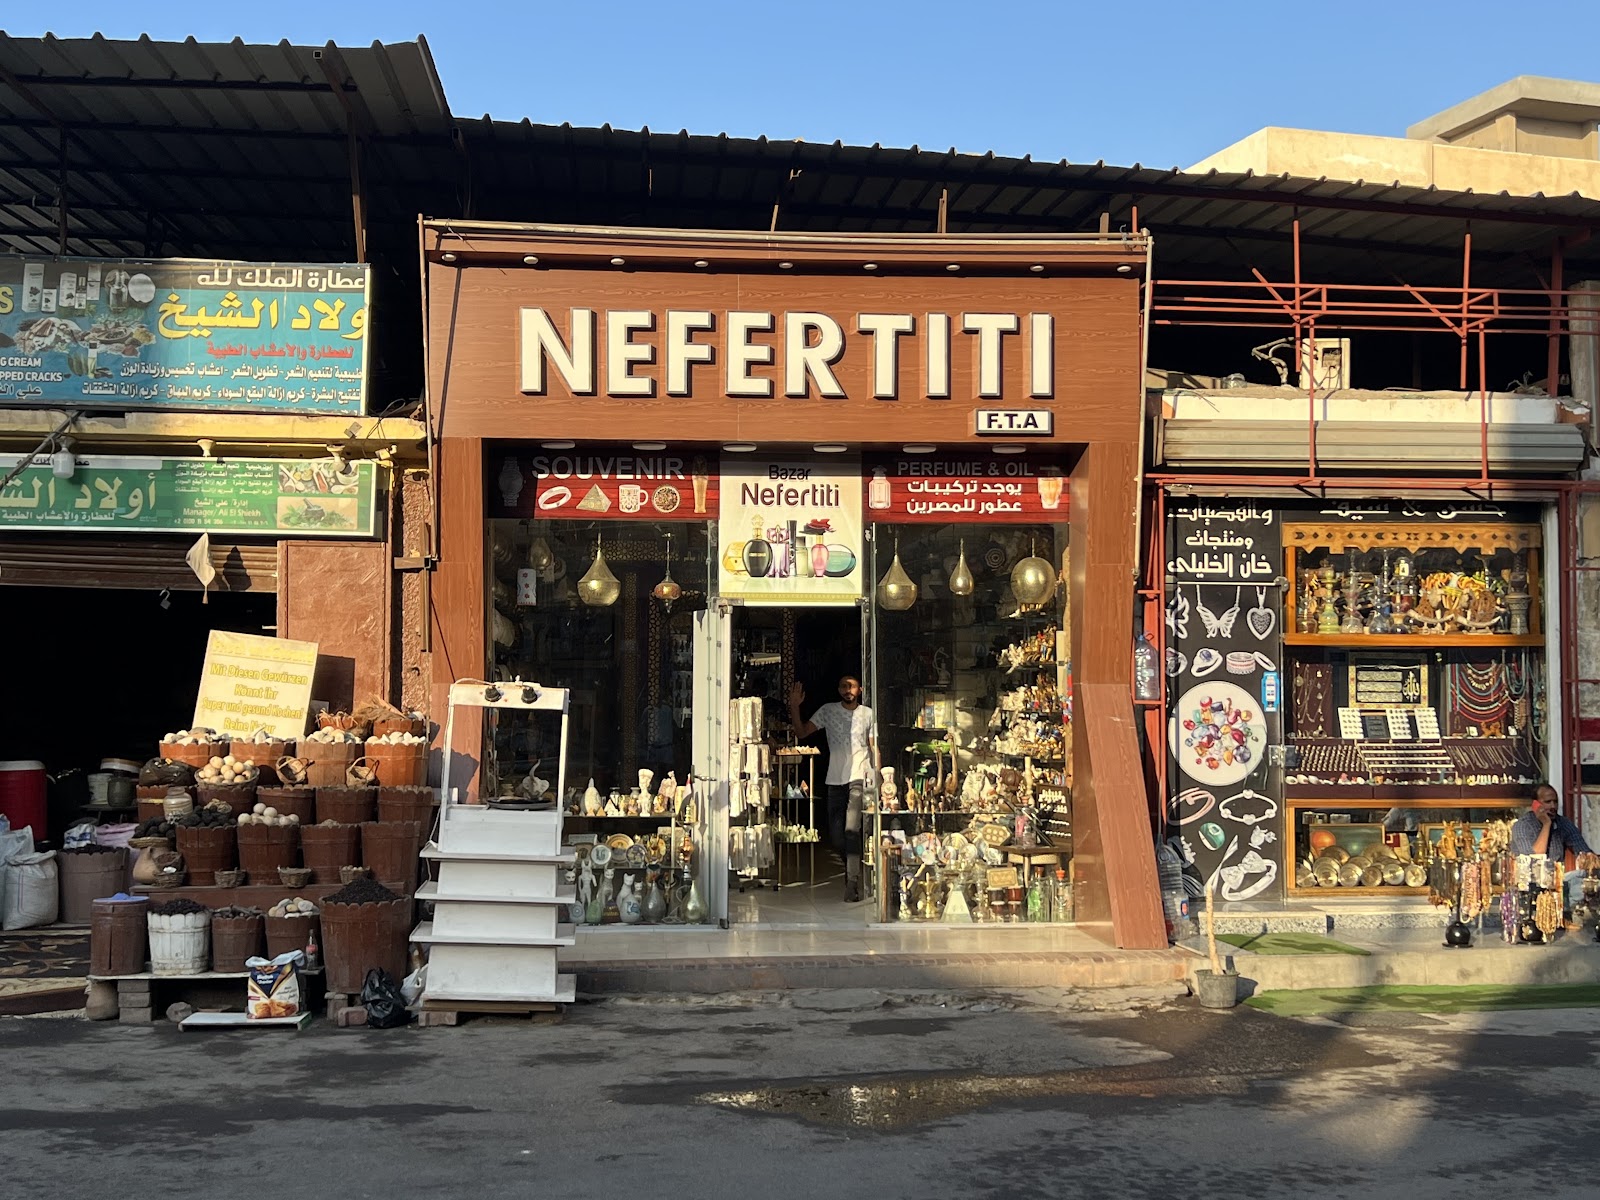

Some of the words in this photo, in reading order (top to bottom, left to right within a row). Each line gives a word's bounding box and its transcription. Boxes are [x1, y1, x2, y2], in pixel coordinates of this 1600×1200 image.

[197, 267, 232, 286] لله
[237, 268, 303, 288] الملك
[307, 269, 364, 293] عطارة
[157, 291, 279, 340] الشيخ
[308, 343, 354, 361] للعطارة
[519, 306, 1056, 399] NEFERTITI
[8, 357, 42, 368] CREAM
[230, 363, 252, 379] الشعر
[25, 372, 63, 382] CRACKS
[284, 364, 307, 381] الشعر
[139, 383, 158, 400] كريم
[192, 384, 211, 401] كريم
[286, 387, 305, 402] كريم
[311, 386, 337, 402] البشرة
[986, 412, 1040, 429] F.T.A
[531, 456, 685, 480] SOUVENIR
[768, 464, 811, 480] Bazar
[897, 462, 982, 476] PERFUME
[988, 462, 1000, 476] &
[1005, 462, 1034, 476] OIL
[74, 472, 156, 519] أولاد
[741, 482, 839, 506] Nefertiti
[907, 480, 978, 497] تركيبات
[979, 482, 1022, 497] يوجد
[906, 498, 975, 514] للمصرين
[978, 498, 1022, 514] عطور
[1185, 529, 1254, 550] ومنتجات
[1239, 553, 1273, 579] خان
[209, 662, 227, 677] Mit
[228, 665, 260, 680] Diesen
[261, 668, 308, 686] Gewürzen
[234, 684, 263, 699] Könnt
[226, 700, 242, 712] und
[242, 703, 272, 717] gesund
[224, 717, 249, 732] Reine
[250, 720, 277, 735] Nur
